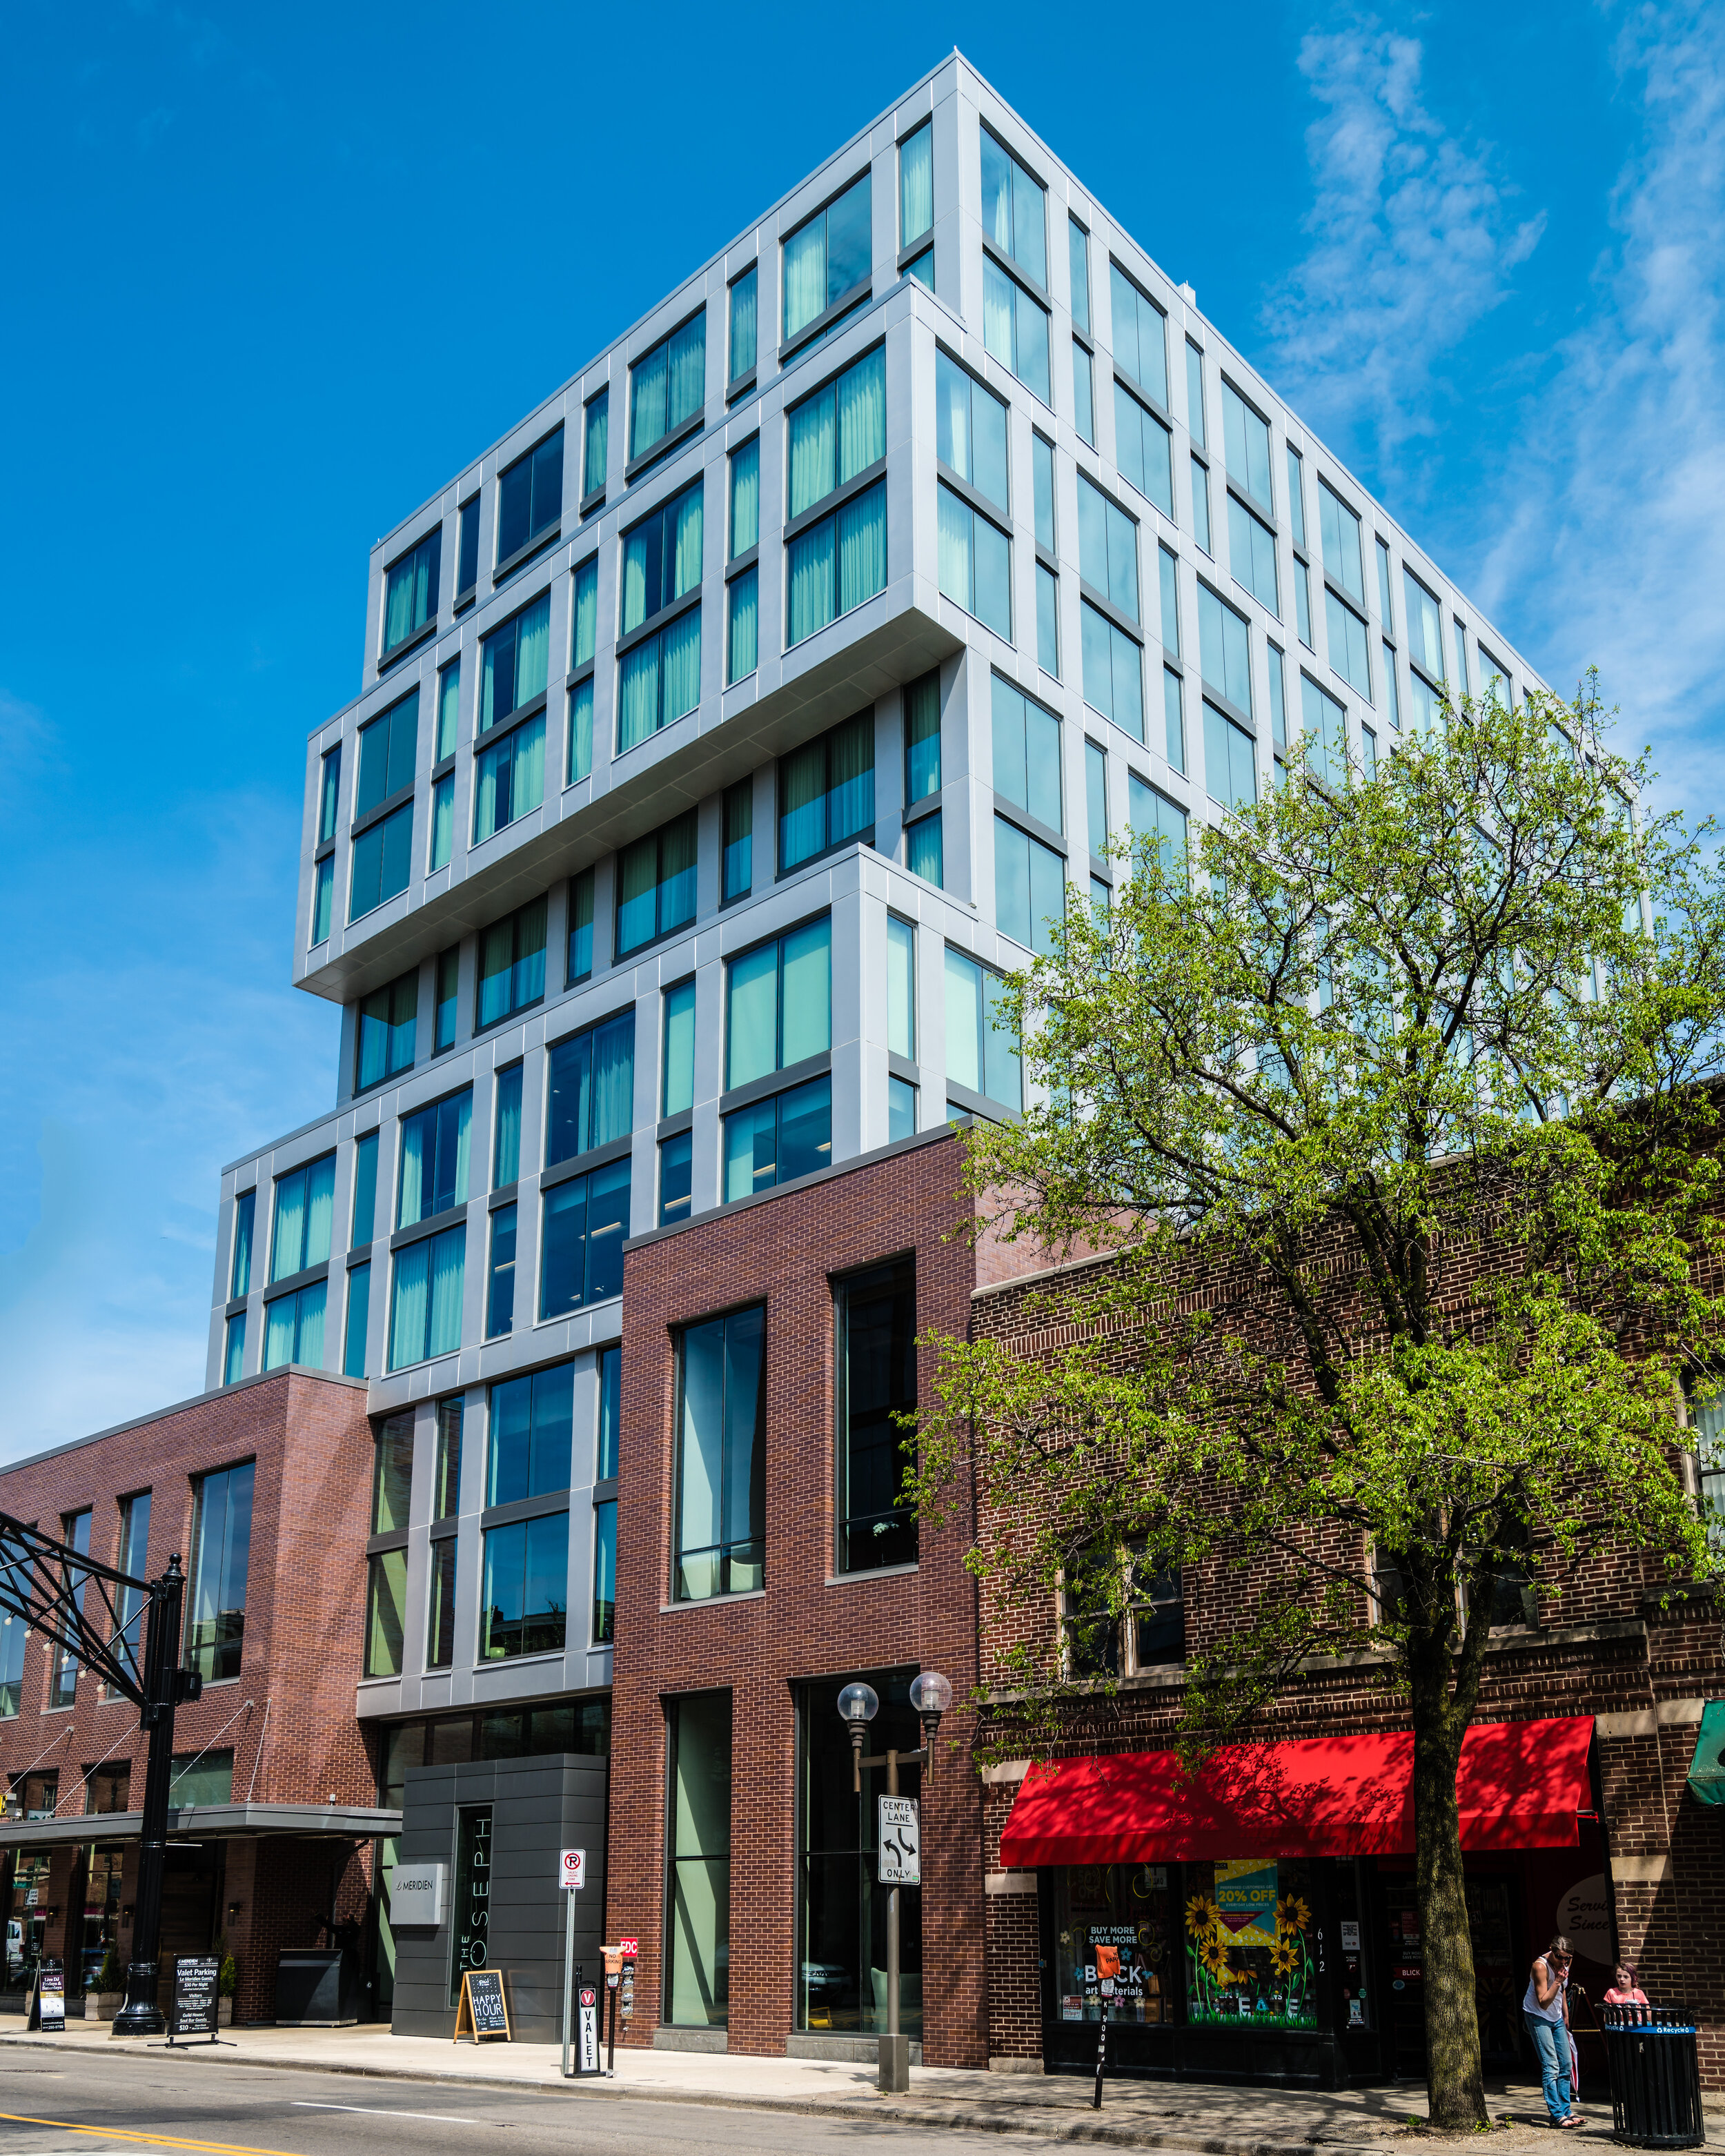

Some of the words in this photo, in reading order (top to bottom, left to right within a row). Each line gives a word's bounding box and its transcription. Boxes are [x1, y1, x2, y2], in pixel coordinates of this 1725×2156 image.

[883, 1801, 915, 1812] CENTER
[888, 1812, 910, 1822] LANE
[887, 1869, 910, 1878] ONLY
[403, 1881, 433, 1890] MERIDIEN
[471, 1819, 491, 1966] OSEPH
[1218, 1890, 1248, 1902] 20%
[1250, 1889, 1276, 1902] OFF
[1567, 1897, 1609, 1912] Servi
[1569, 1915, 1610, 1930] Since
[460, 1935, 470, 1970] THE
[194, 1968, 217, 1977] Parking
[1085, 1965, 1142, 1984] BCK
[1085, 1986, 1098, 1995] art
[1113, 1986, 1143, 1996] terials
[473, 1993, 501, 2005] HAPPY
[474, 2003, 503, 2017] HOUR
[584, 2010, 593, 2067] VALET
